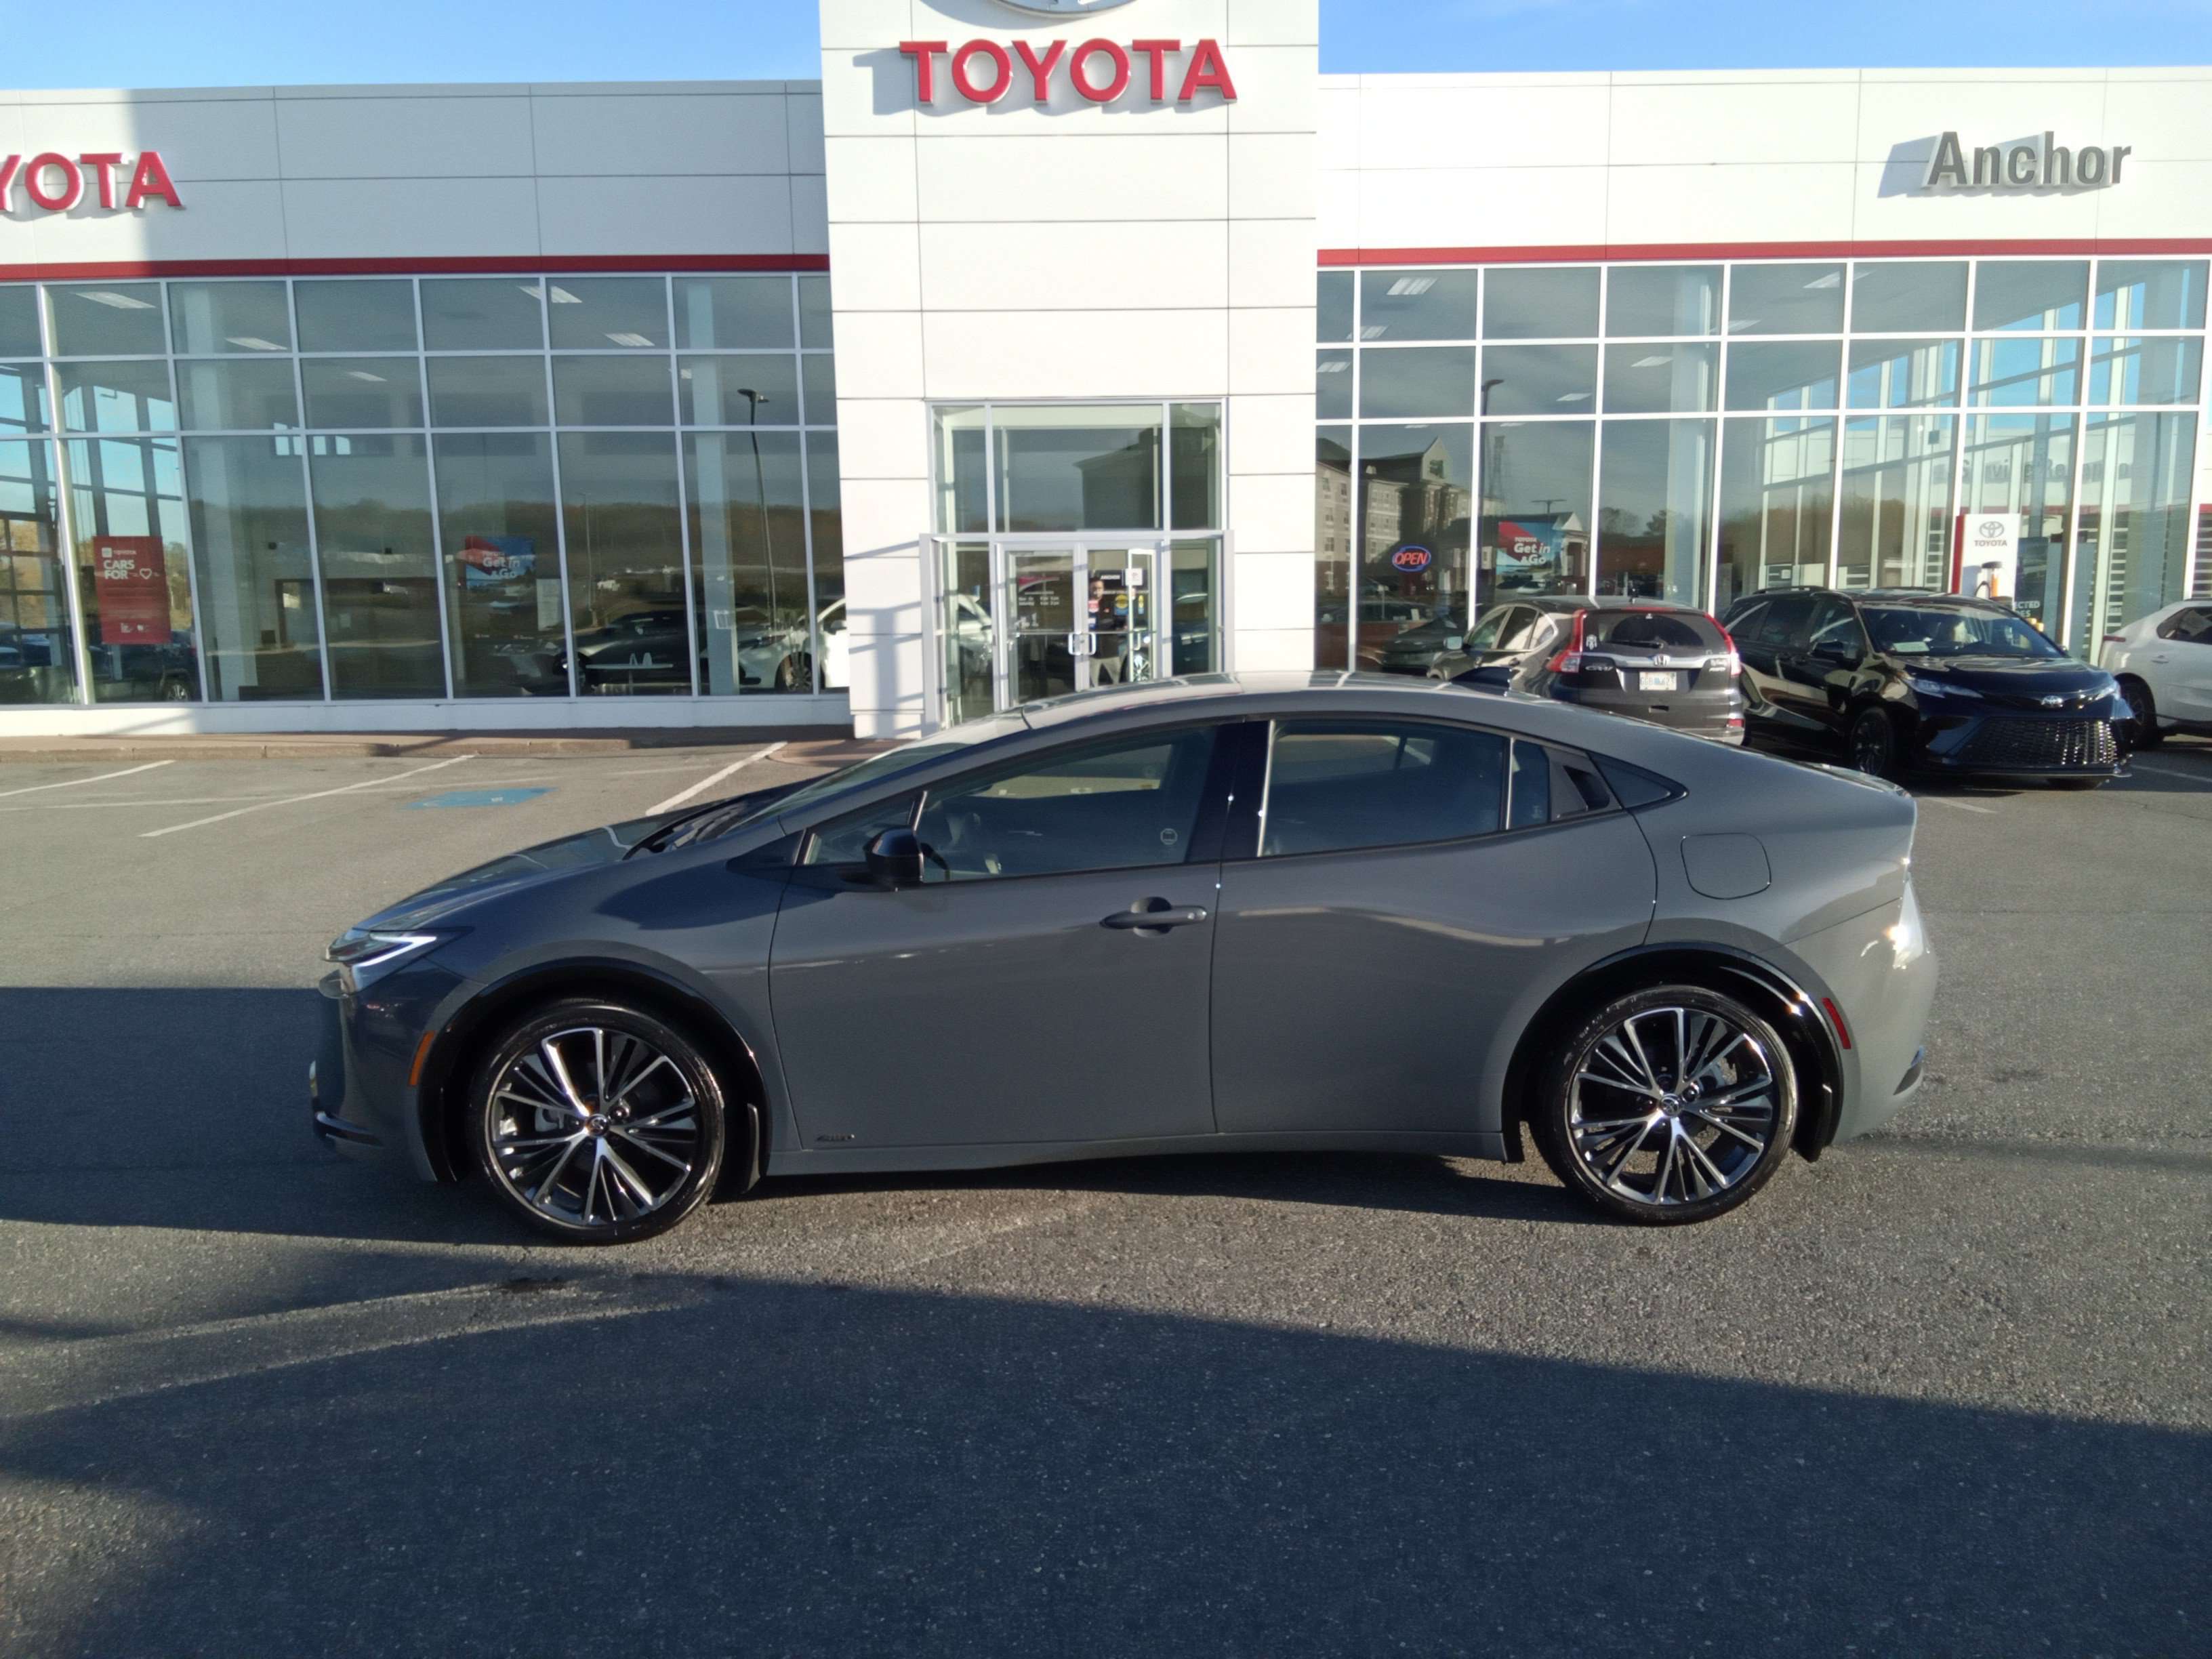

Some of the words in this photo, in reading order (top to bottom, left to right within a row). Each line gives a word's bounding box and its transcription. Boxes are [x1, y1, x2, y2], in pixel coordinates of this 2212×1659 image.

[899, 39, 1237, 103] TOYOTA
[1927, 131, 2132, 184] Anchor
[1513, 543, 1537, 553] Get
[1539, 543, 1551, 553] in
[104, 559, 135, 569] CARS
[483, 557, 506, 567] Get
[509, 556, 520, 567] in
[1394, 552, 1428, 565] OPEN
[104, 570, 128, 579] FOR
